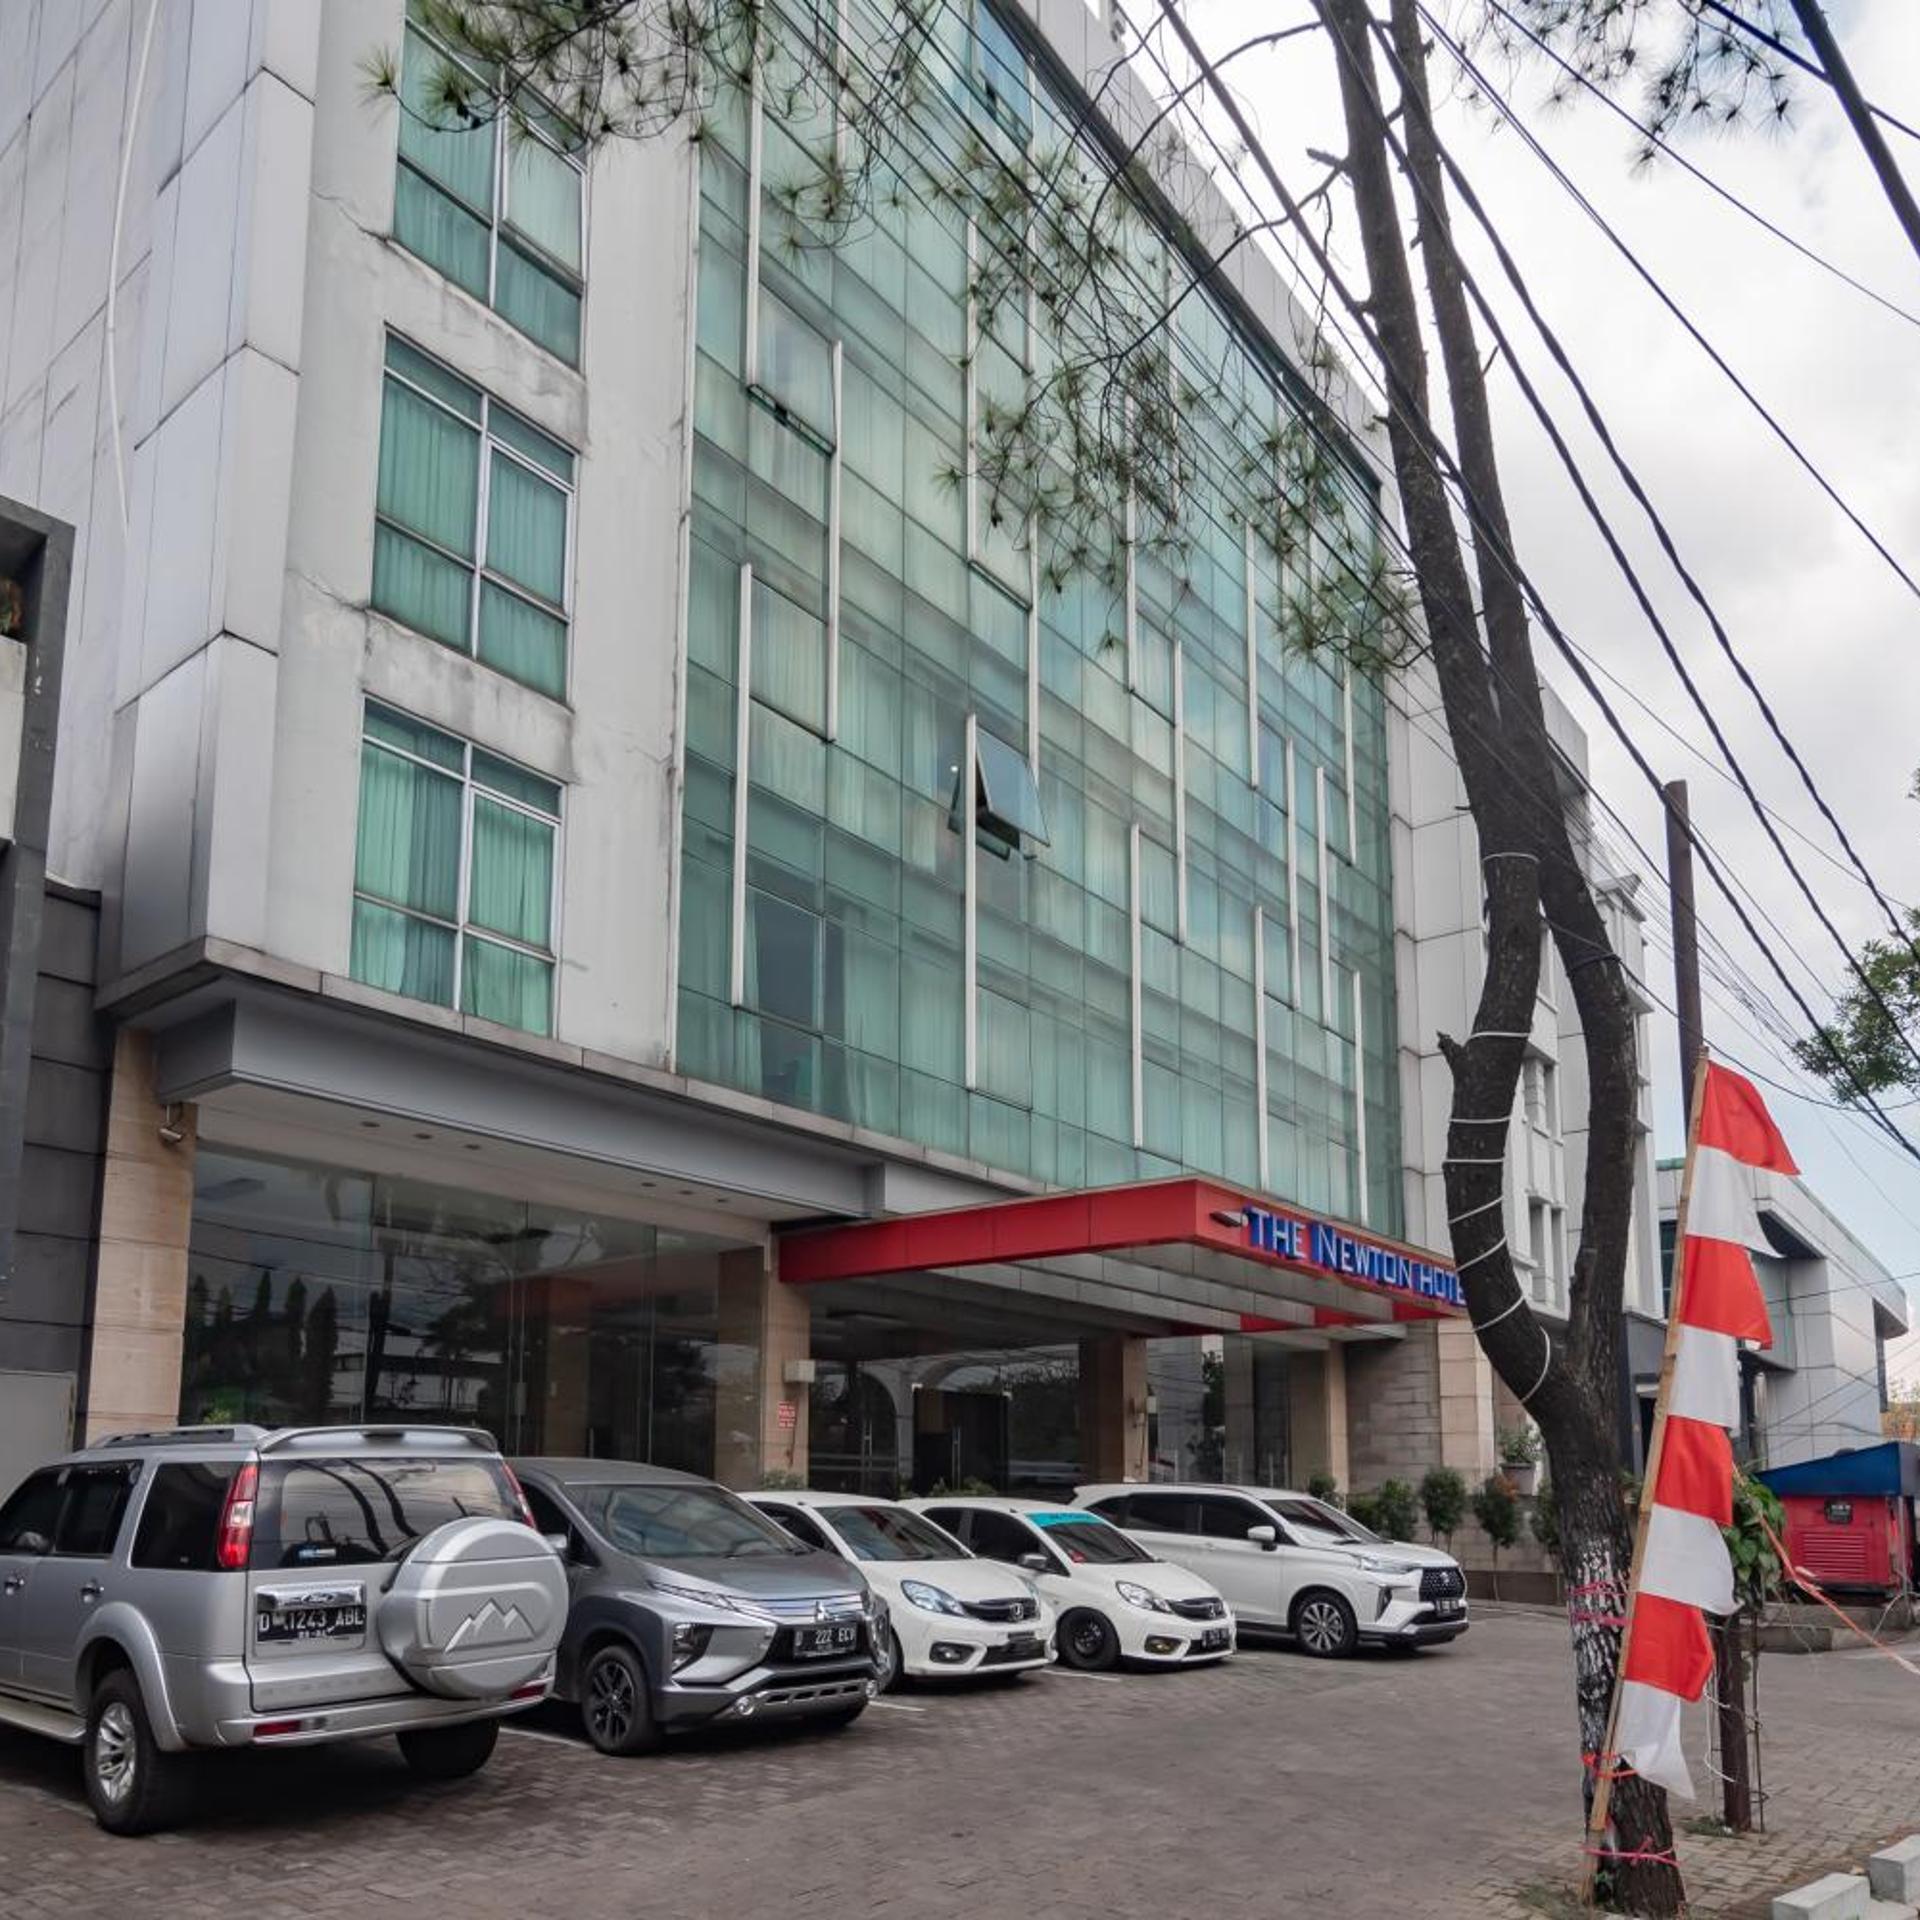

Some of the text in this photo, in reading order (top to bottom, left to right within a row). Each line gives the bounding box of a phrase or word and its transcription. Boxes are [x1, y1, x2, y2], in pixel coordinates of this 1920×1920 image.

[1247, 1205, 1467, 1306] THE NEWTON HOTE
